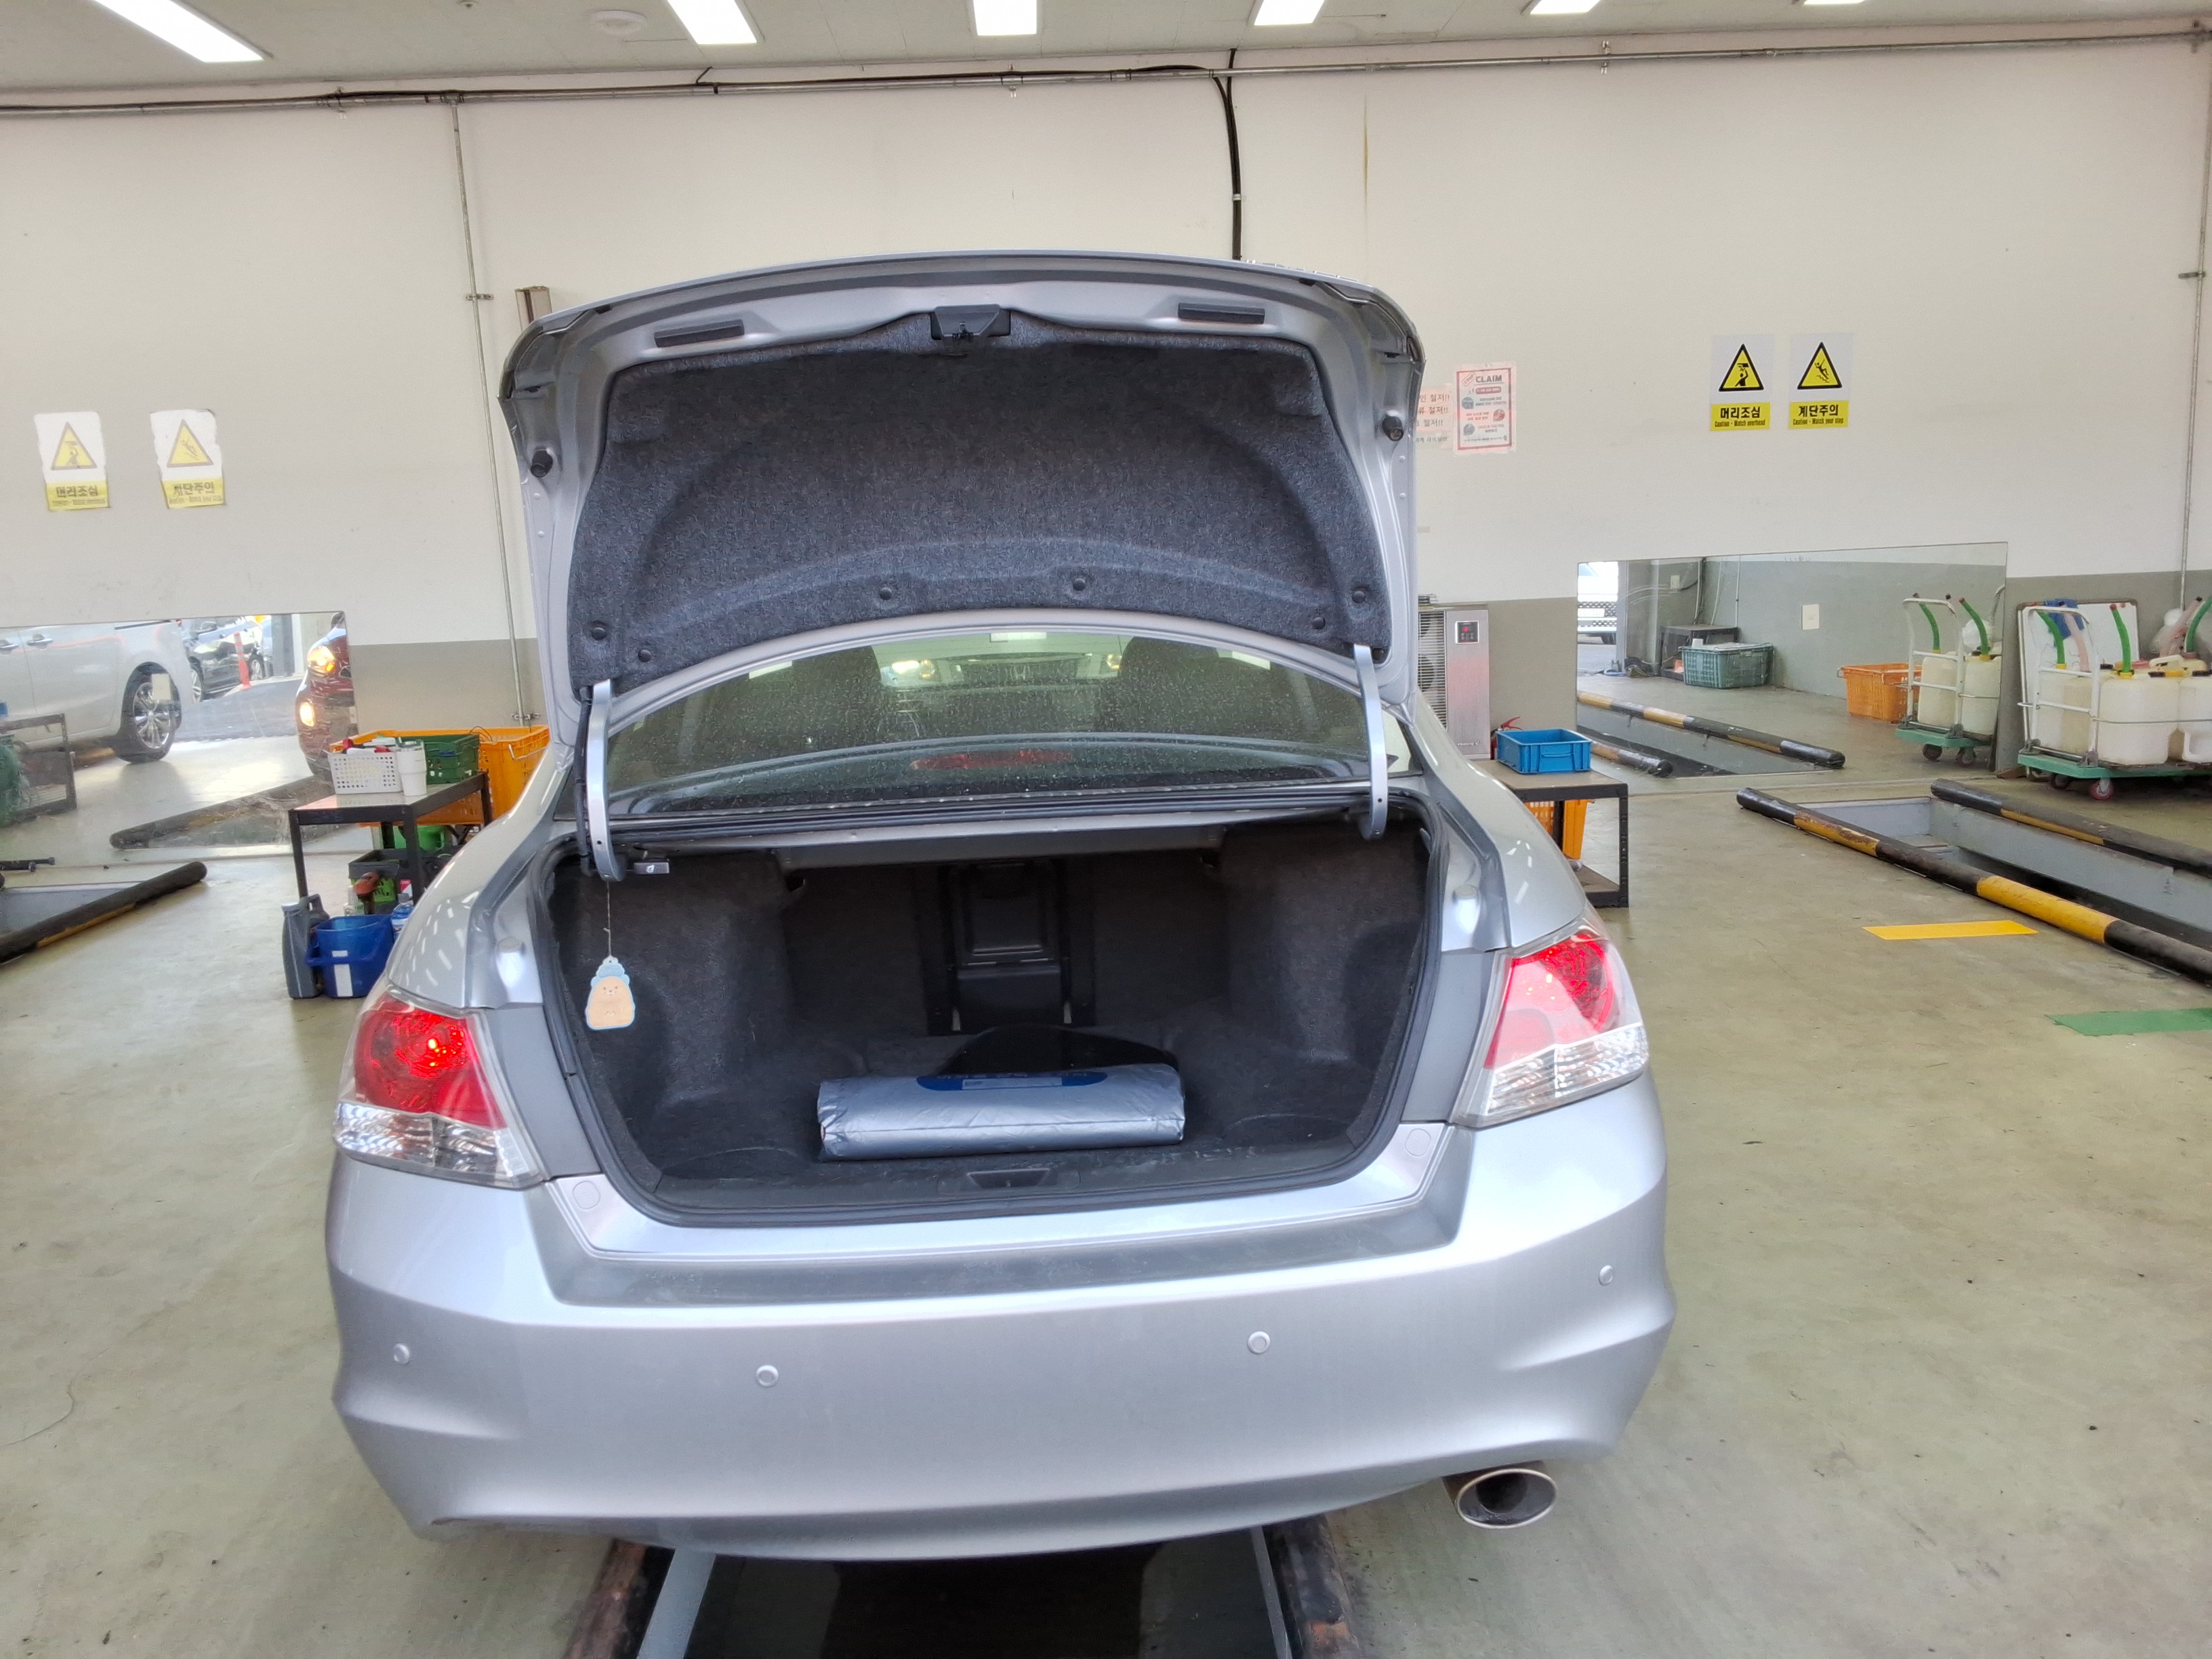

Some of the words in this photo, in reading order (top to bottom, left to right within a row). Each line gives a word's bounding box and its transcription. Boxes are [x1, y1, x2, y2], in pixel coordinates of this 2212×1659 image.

[1475, 375, 1502, 383] CLAIM
[1720, 407, 1761, 419] 머리조심
[1798, 405, 1839, 417] 계단주의
